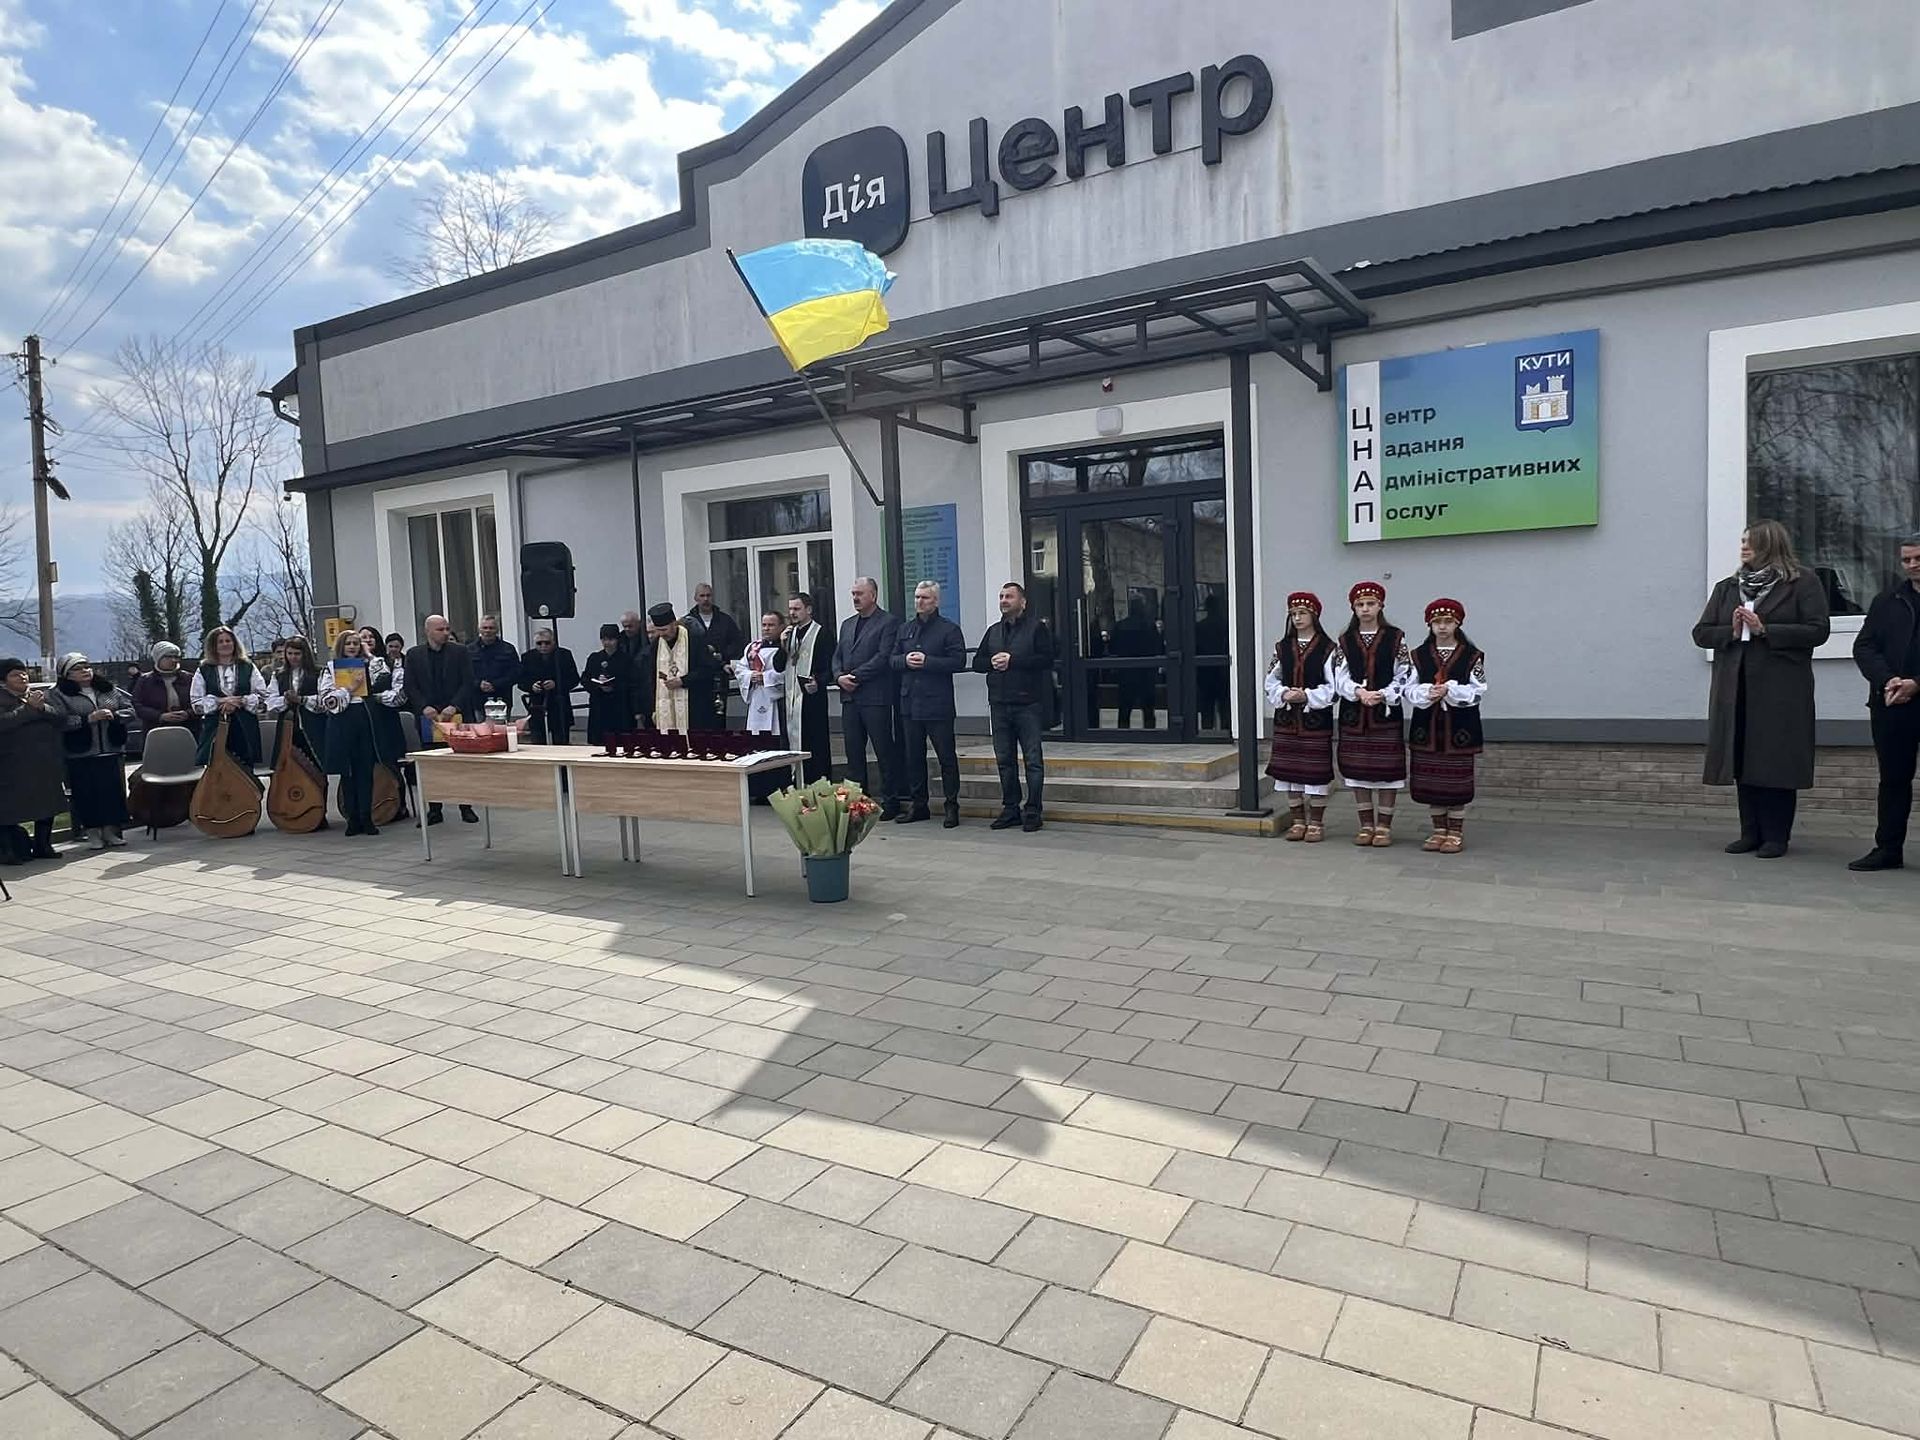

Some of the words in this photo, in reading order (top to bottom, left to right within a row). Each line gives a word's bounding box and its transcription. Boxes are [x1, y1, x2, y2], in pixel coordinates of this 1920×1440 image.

[823, 173, 886, 228] Дія
[926, 54, 1274, 218] Центр
[1518, 352, 1571, 372] КУТИ
